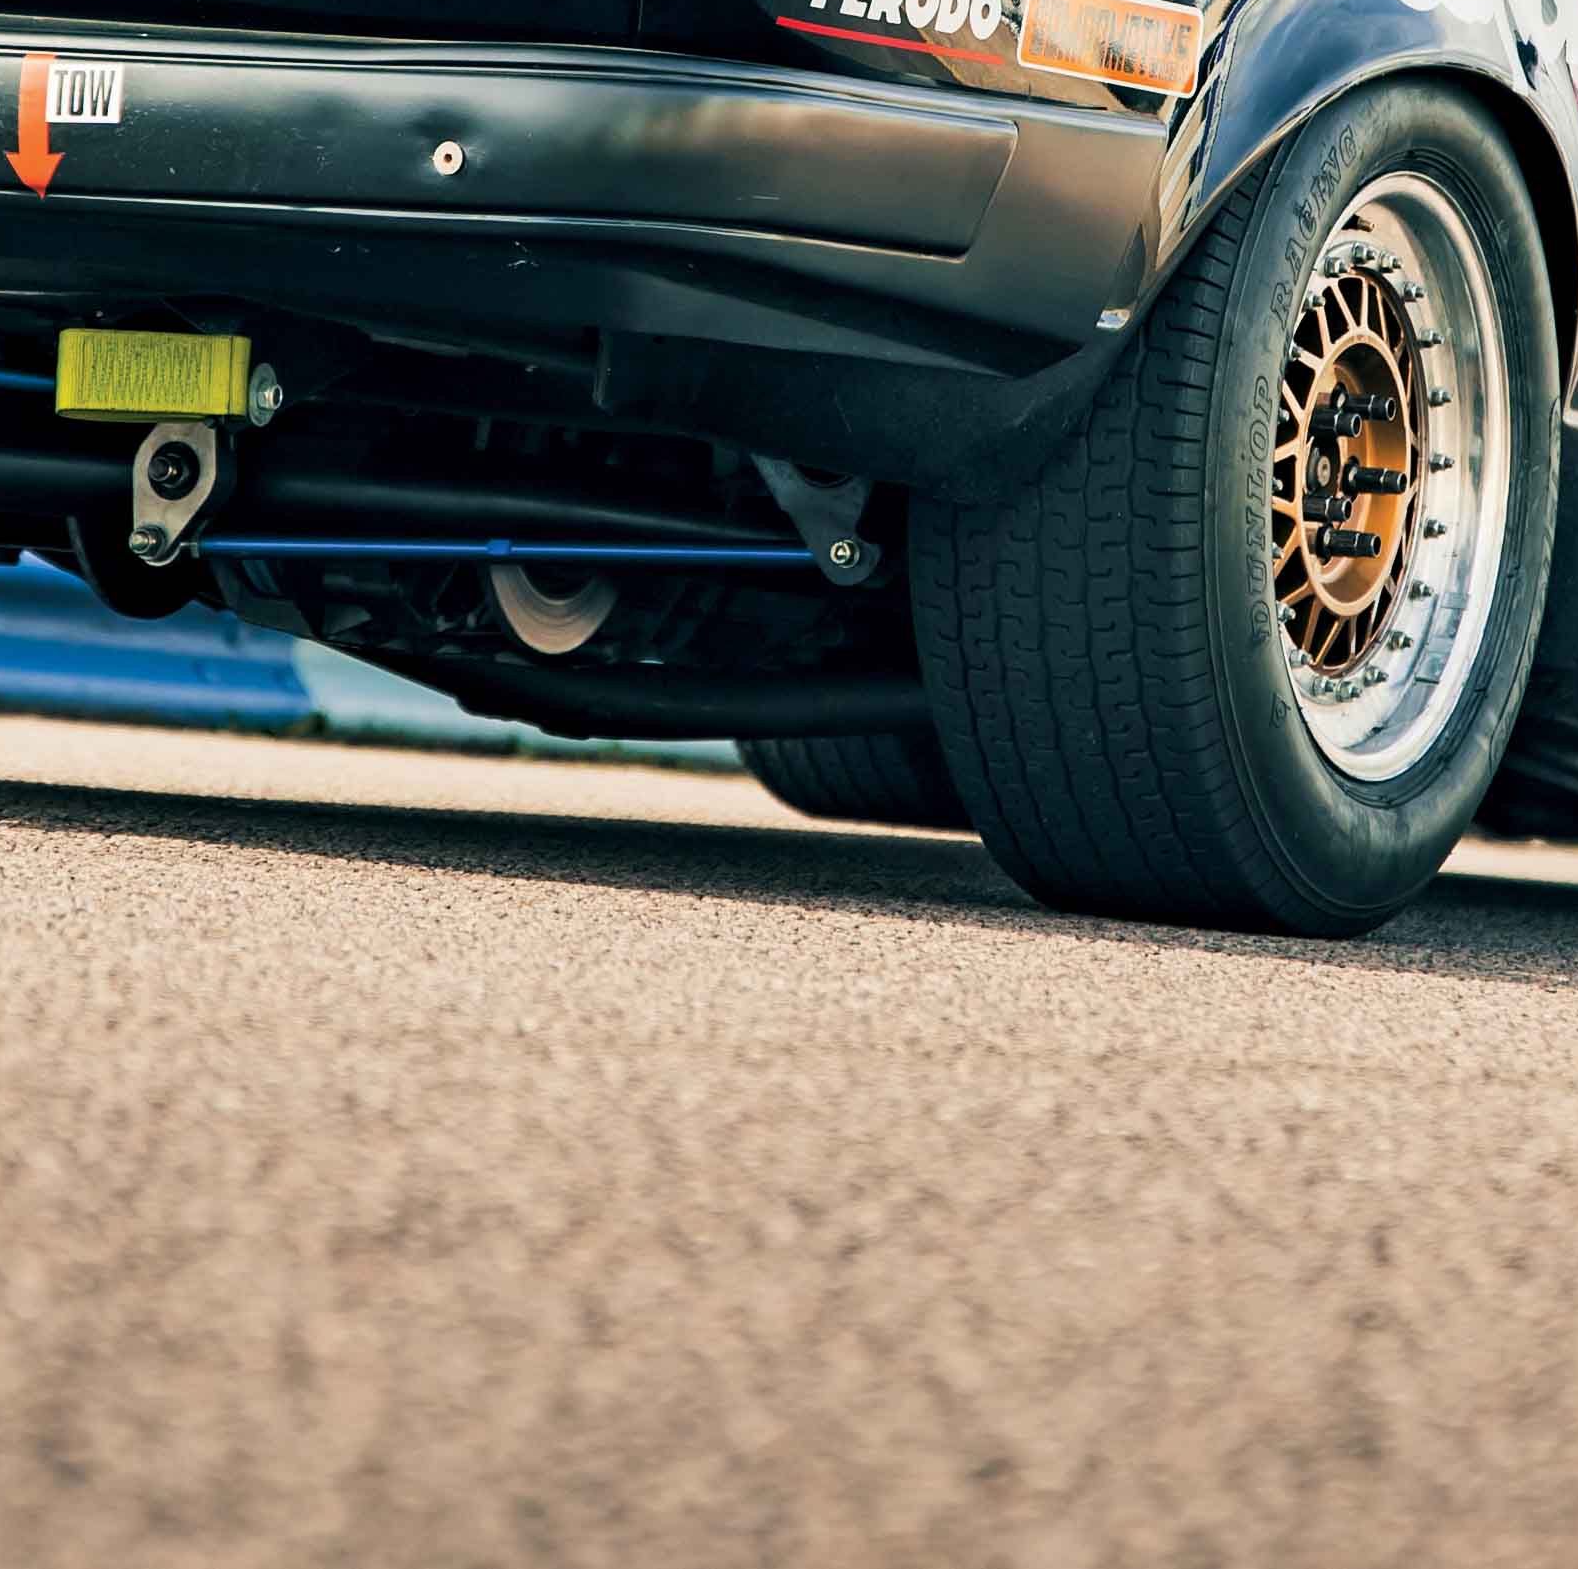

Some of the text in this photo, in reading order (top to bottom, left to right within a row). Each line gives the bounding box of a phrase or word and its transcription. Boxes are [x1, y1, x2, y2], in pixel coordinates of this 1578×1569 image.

[53, 69, 116, 118] TOW
[1245, 124, 1359, 643] DUNLOP RACING
